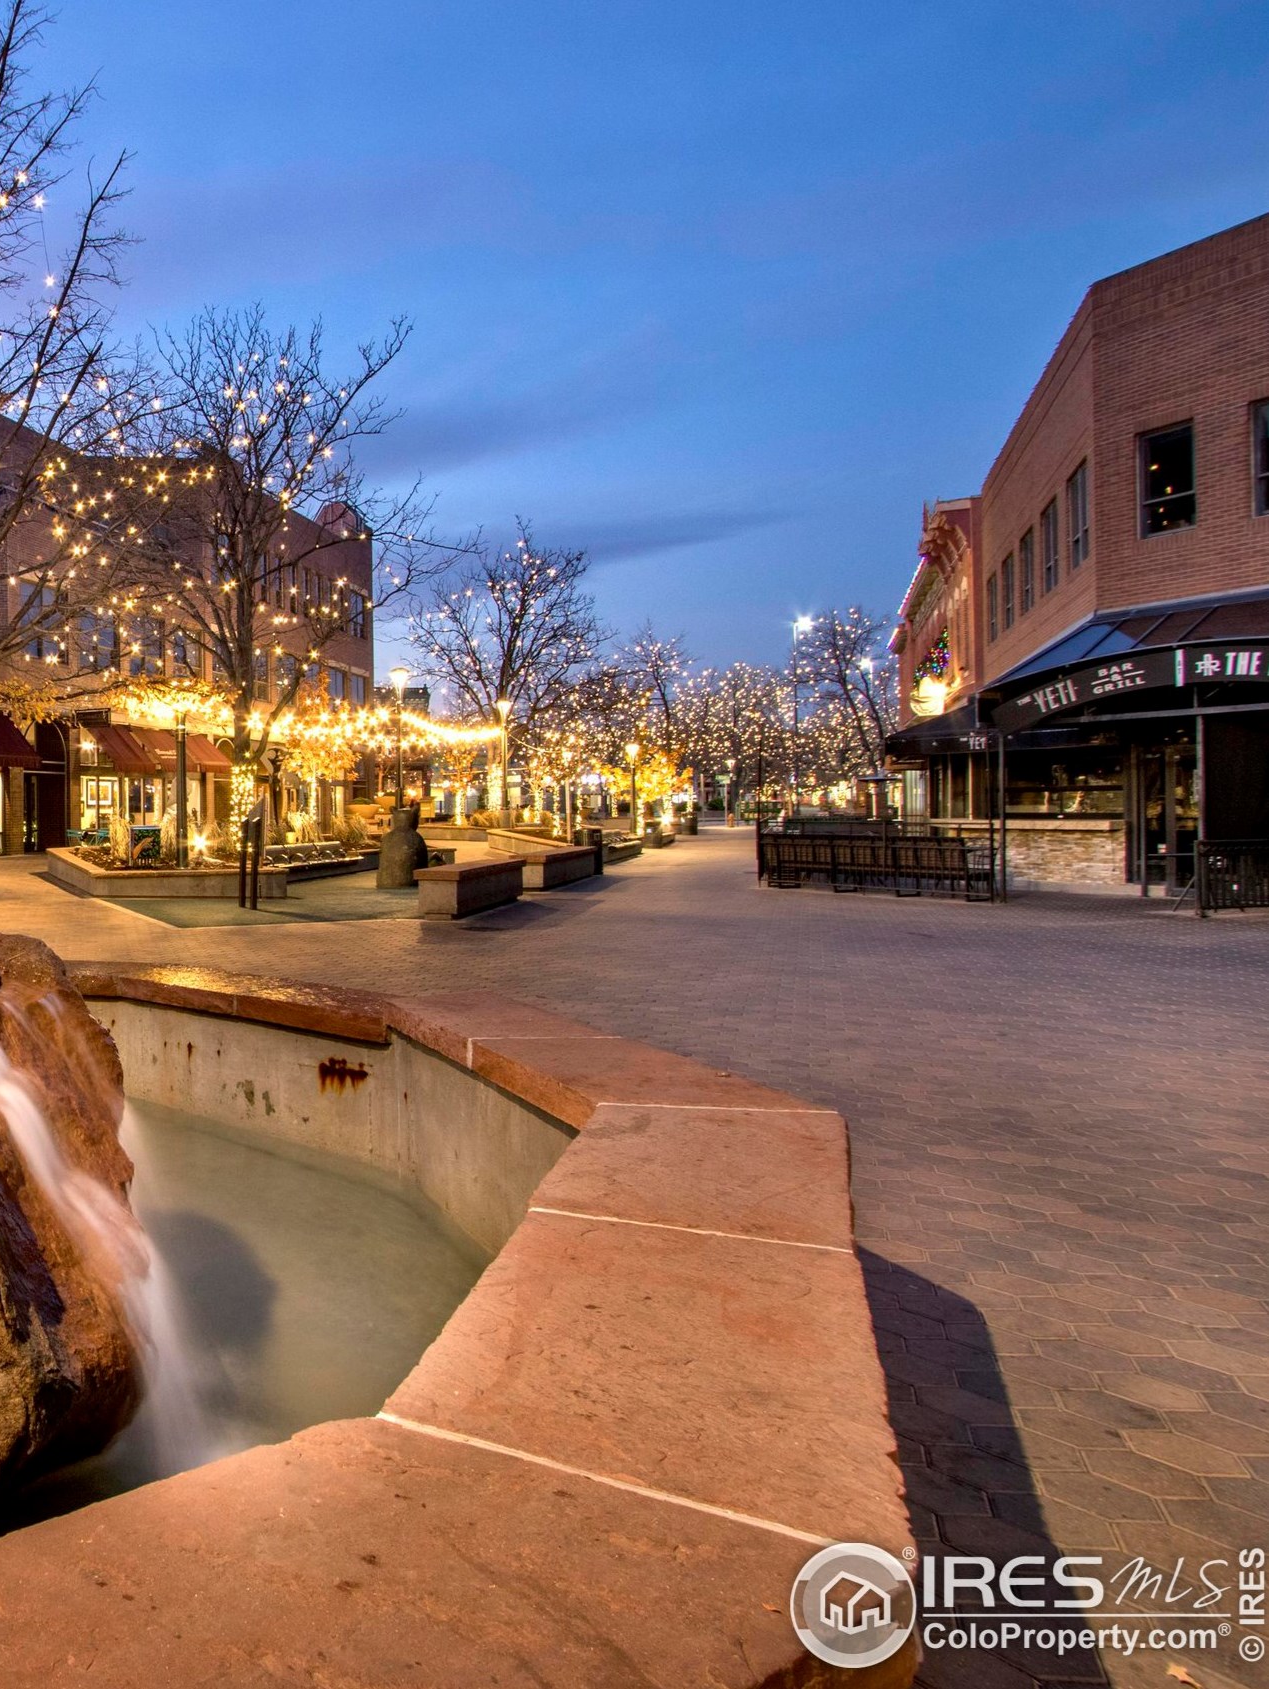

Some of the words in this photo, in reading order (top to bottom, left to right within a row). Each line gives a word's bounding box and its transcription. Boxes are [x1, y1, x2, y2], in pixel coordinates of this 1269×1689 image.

[1097, 662, 1134, 677] BAR
[1225, 651, 1262, 676] THE
[1033, 679, 1078, 713] YETI
[1092, 676, 1146, 695] GRILL
